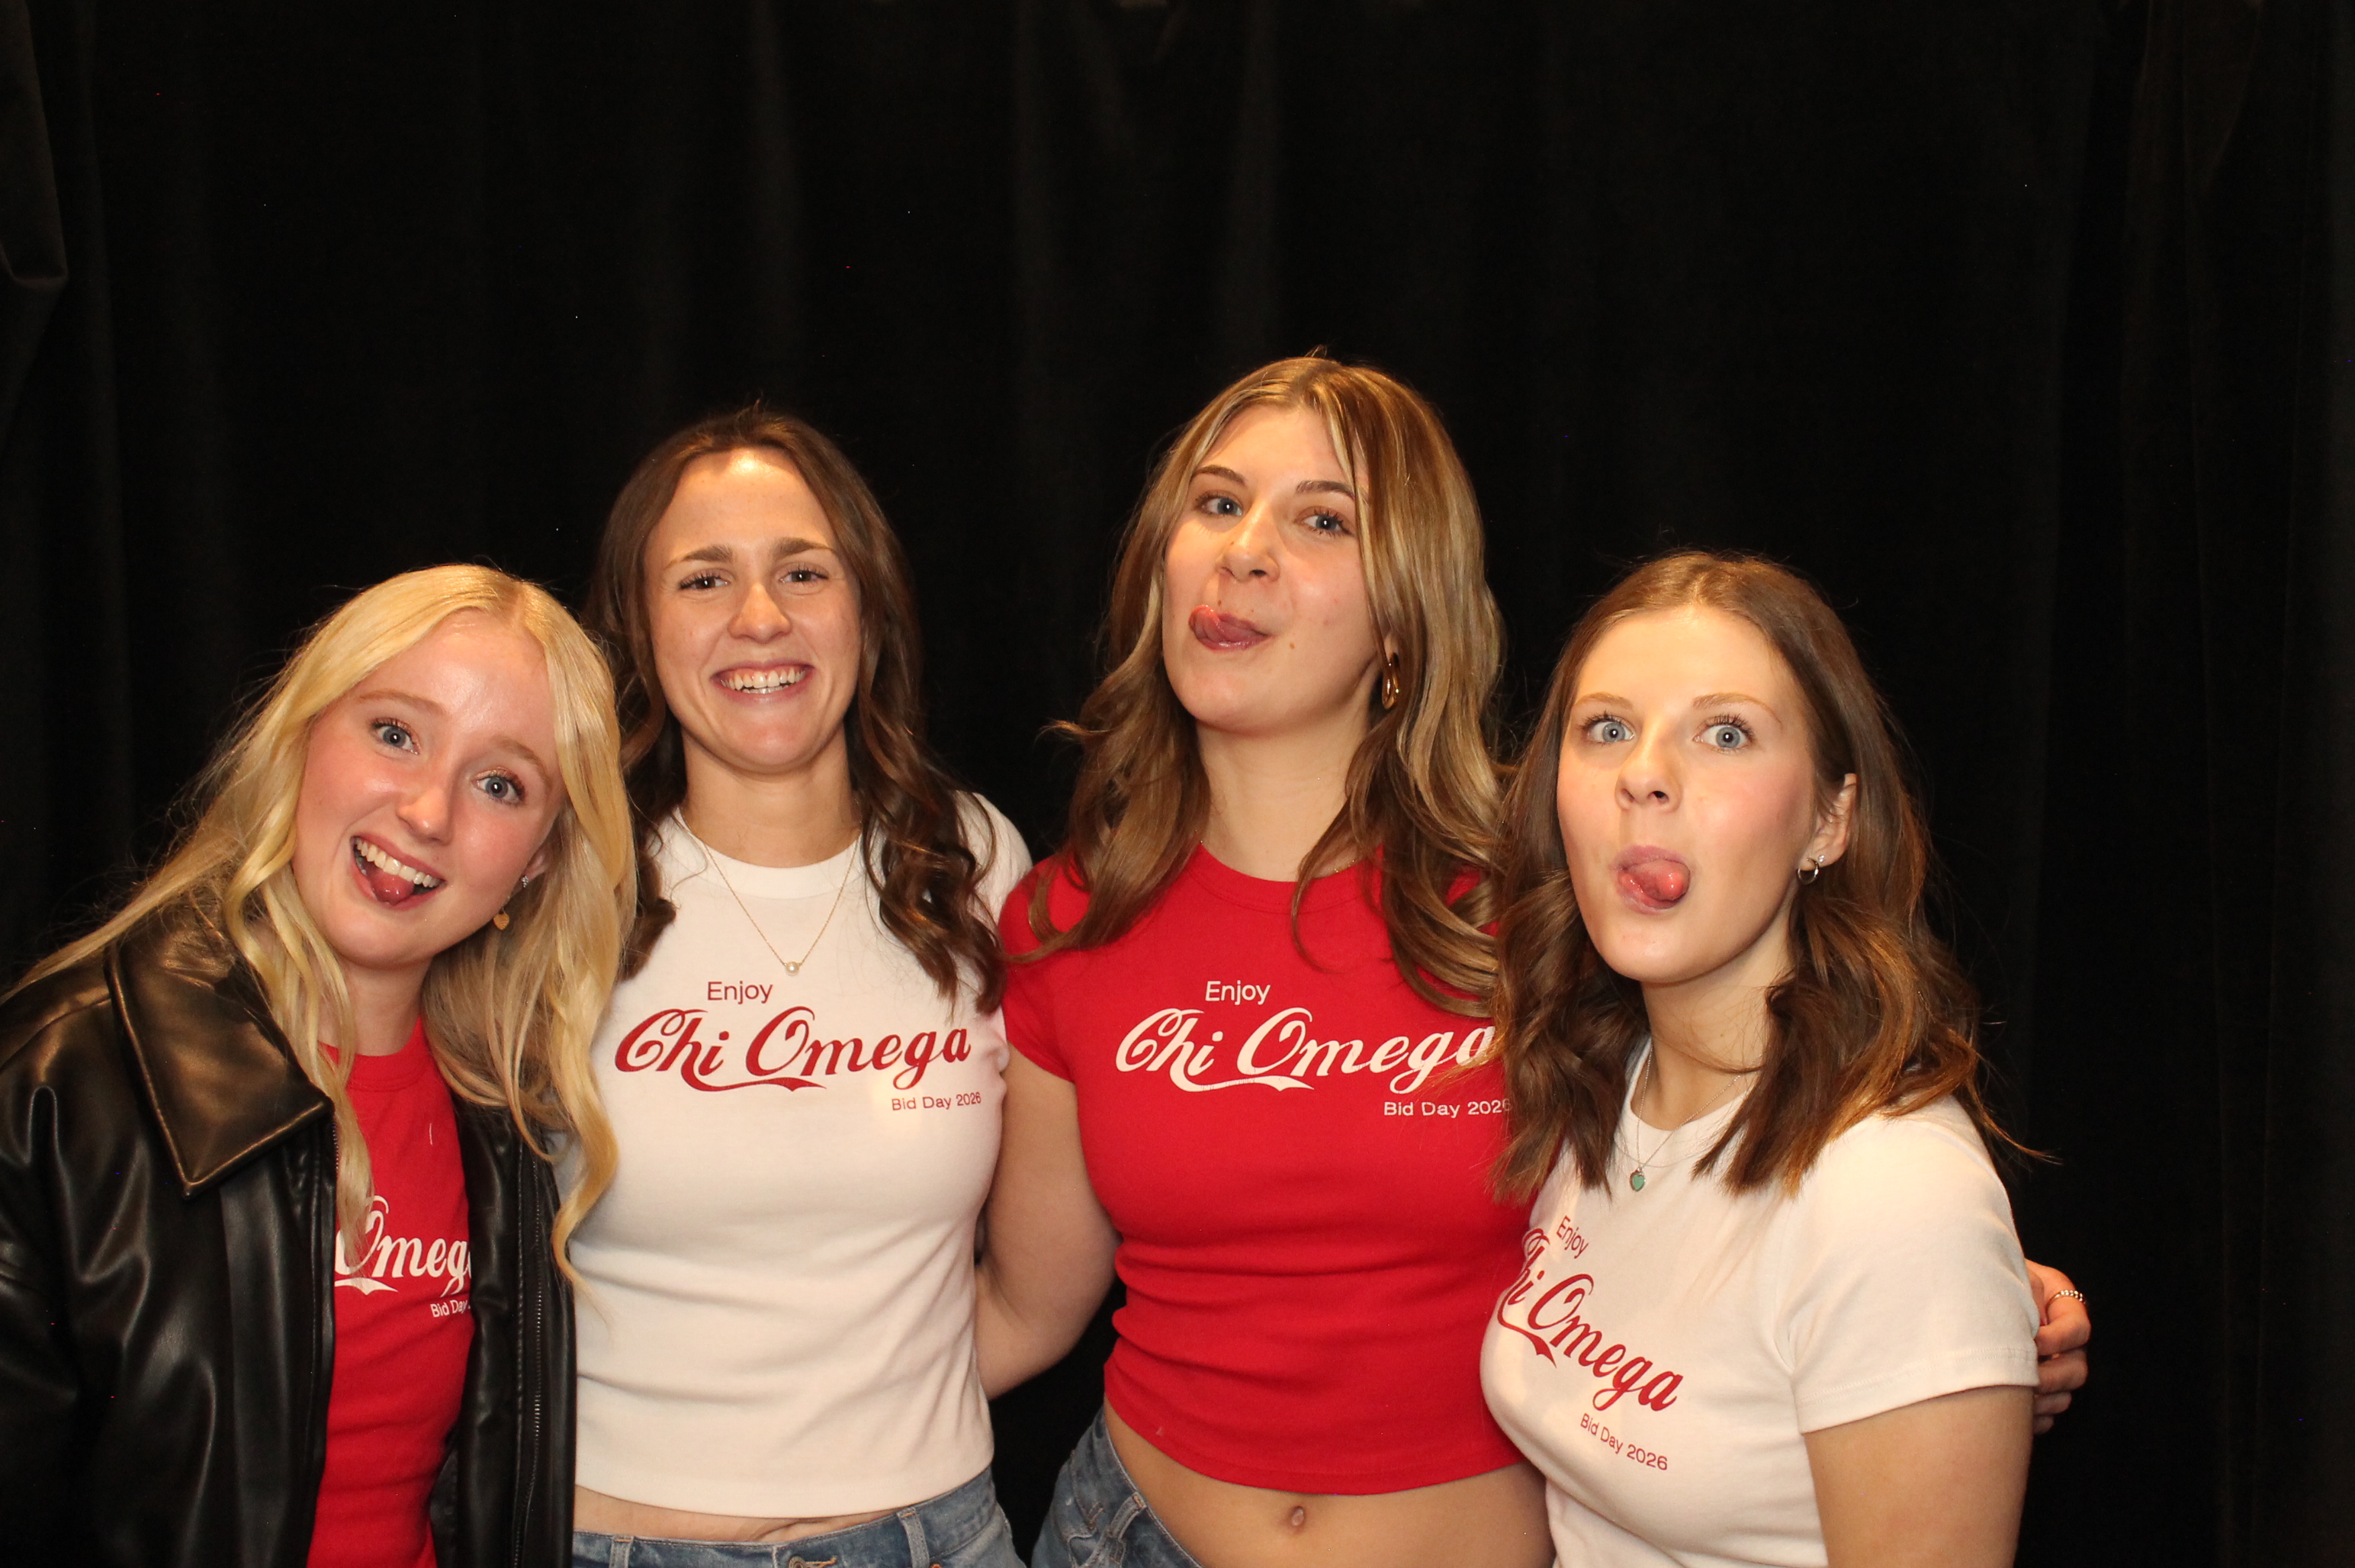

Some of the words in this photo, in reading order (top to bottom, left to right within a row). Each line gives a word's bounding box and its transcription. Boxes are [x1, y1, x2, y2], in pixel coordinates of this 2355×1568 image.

[707, 981, 773, 1005] Enjoy
[1205, 980, 1271, 1005] Enjoy
[615, 1008, 730, 1092] Chi
[745, 1006, 972, 1091] Omega
[1115, 1007, 1223, 1092] Chi
[1235, 1007, 1495, 1094] Omega
[891, 1097, 917, 1111] Bid
[922, 1095, 952, 1111] Day
[956, 1091, 982, 1107] 2026
[1383, 1101, 1414, 1117] Bid
[1422, 1101, 1460, 1119] Day
[1467, 1099, 1512, 1117] 2026
[335, 1195, 471, 1297] Omeg
[1556, 1215, 1589, 1260] Enjoy
[430, 1302, 450, 1318] Bid
[450, 1299, 468, 1315] Day
[1528, 1273, 1684, 1412] Omega
[1580, 1412, 1600, 1436] Bid
[1600, 1426, 1624, 1454] Day
[1627, 1444, 1668, 1471] 2026
